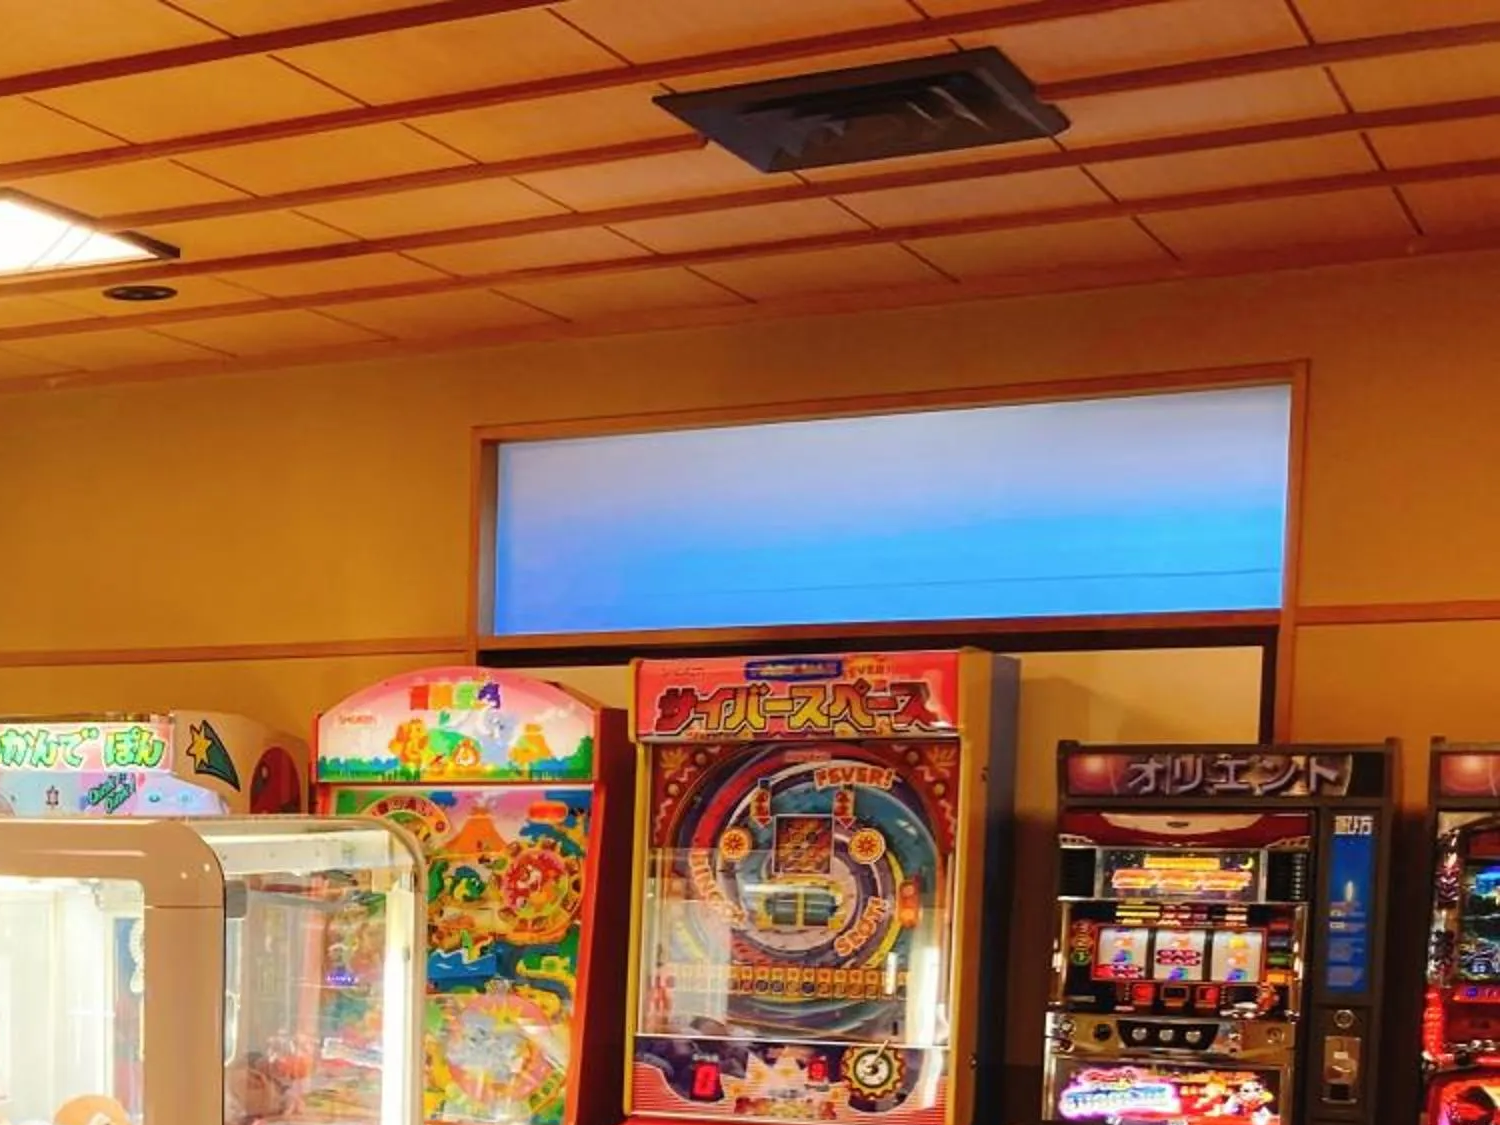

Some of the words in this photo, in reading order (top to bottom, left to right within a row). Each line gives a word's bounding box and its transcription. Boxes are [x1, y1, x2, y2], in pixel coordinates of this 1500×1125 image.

[654, 678, 946, 734] サイバースペース
[815, 766, 894, 789] FEVER!
[1127, 755, 1339, 795] オリエント
